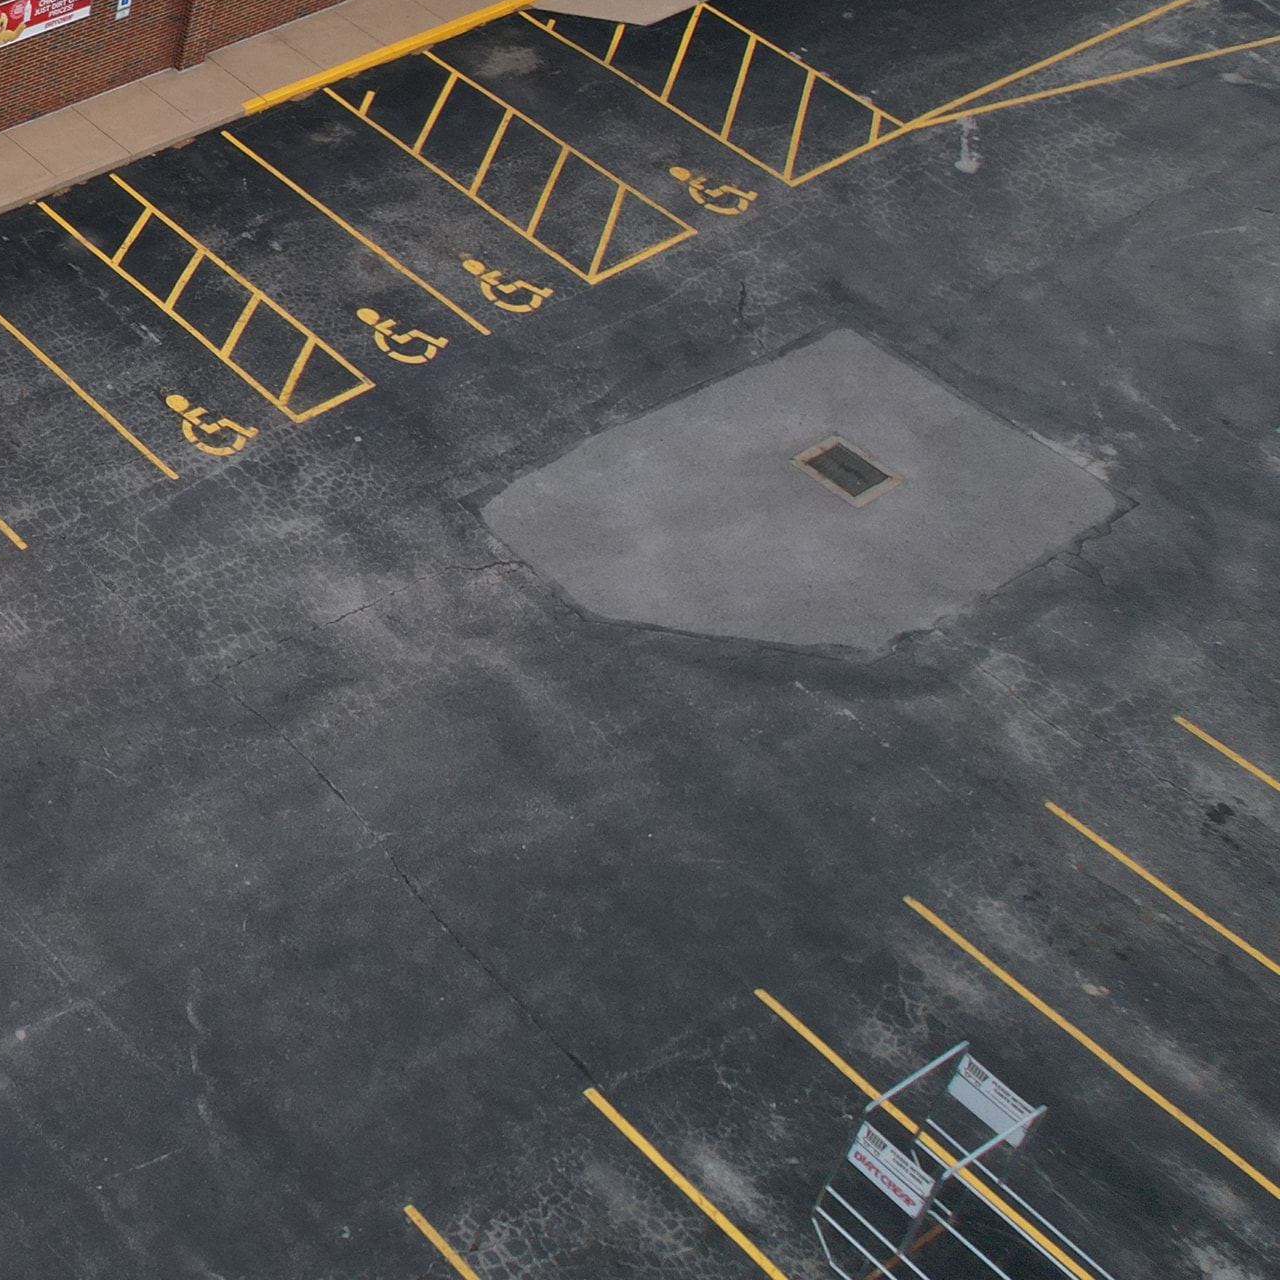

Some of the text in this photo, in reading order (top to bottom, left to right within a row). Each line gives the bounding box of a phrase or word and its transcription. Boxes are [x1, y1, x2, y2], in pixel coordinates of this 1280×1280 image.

[34, 6, 51, 16] JUST
[51, 0, 68, 10] DIRT
[853, 1150, 881, 1178] DIRT
[881, 1175, 916, 1207] CHEAP
